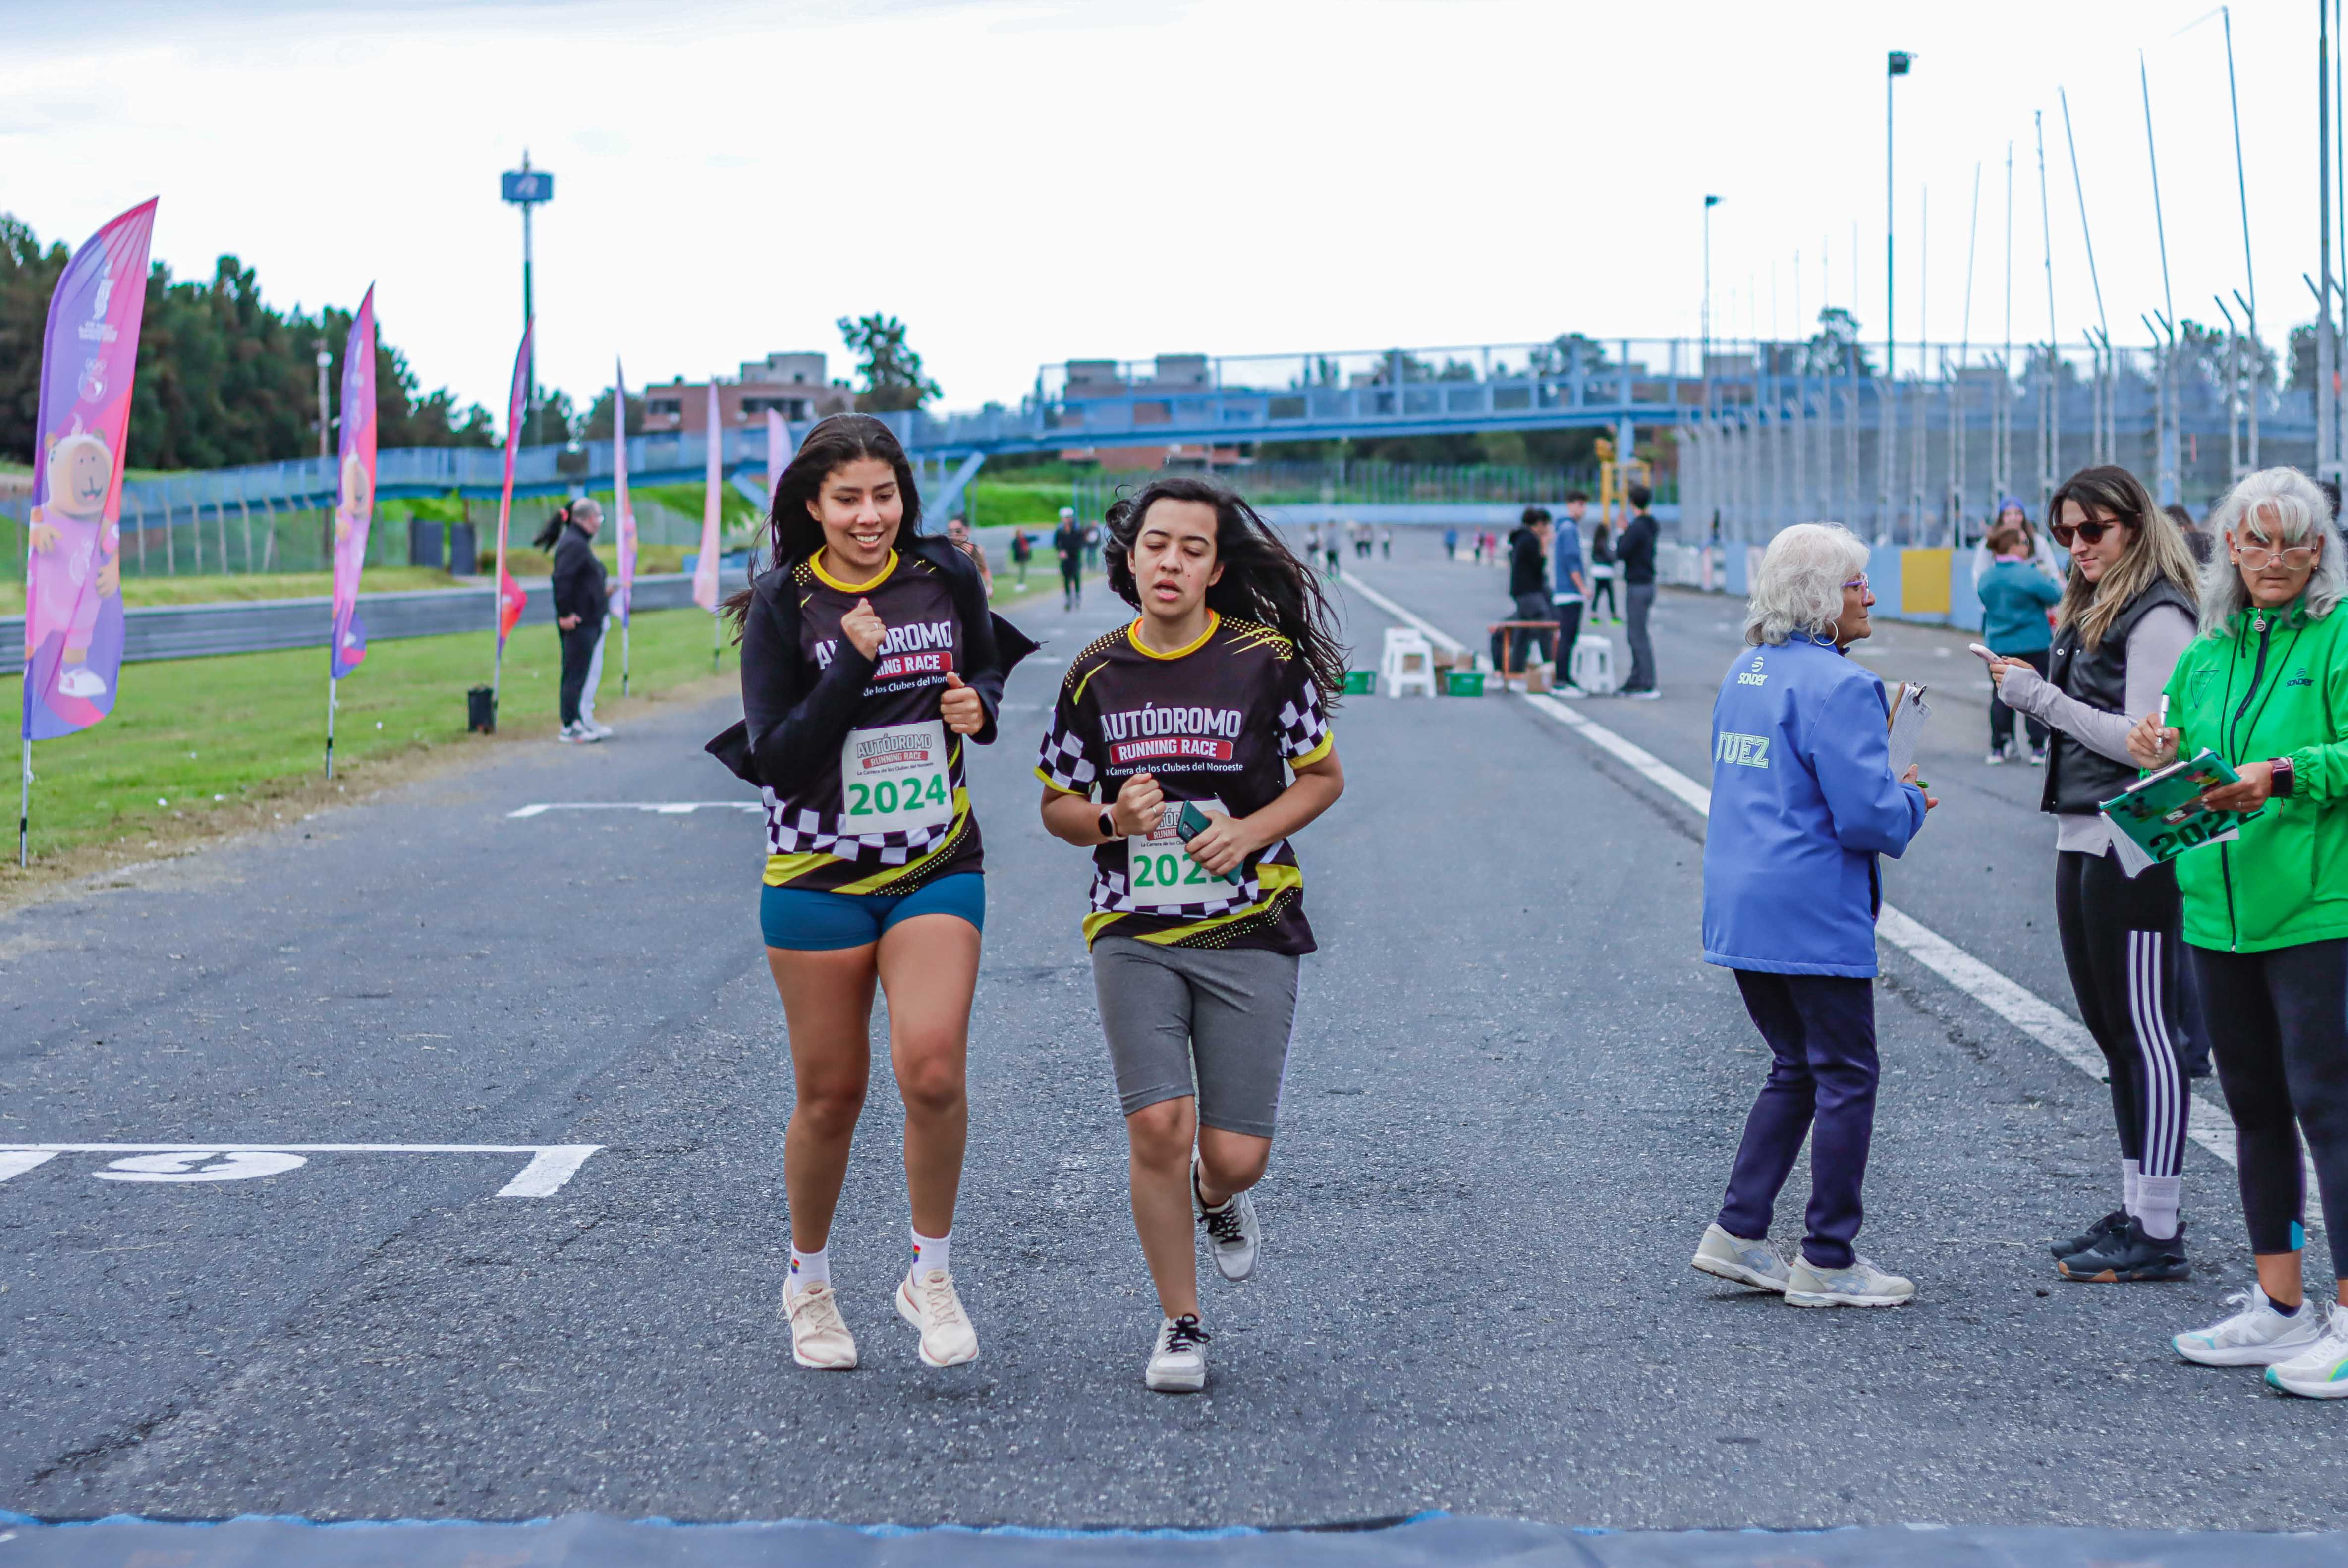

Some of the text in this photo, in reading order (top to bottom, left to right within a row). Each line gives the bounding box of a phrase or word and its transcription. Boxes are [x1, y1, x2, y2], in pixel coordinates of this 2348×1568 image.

[815, 620, 953, 670] ADROMO
[905, 654, 940, 672] RACE
[864, 687, 874, 696] de
[889, 681, 915, 692] Clubes
[917, 676, 930, 686] del
[1100, 702, 1242, 742] AUTÓDROMO
[857, 734, 932, 758] AUTÓDROMO
[1118, 739, 1217, 761] RUNNING RACE
[871, 752, 921, 766] RUNNING RACE
[1136, 765, 1146, 774] de
[1148, 764, 1160, 773] los
[1162, 763, 1190, 772] Clubes
[1207, 762, 1243, 771] Noroeste
[849, 774, 947, 815] 2024
[1153, 828, 1176, 839] RUNNI
[1133, 853, 1226, 887] 202
